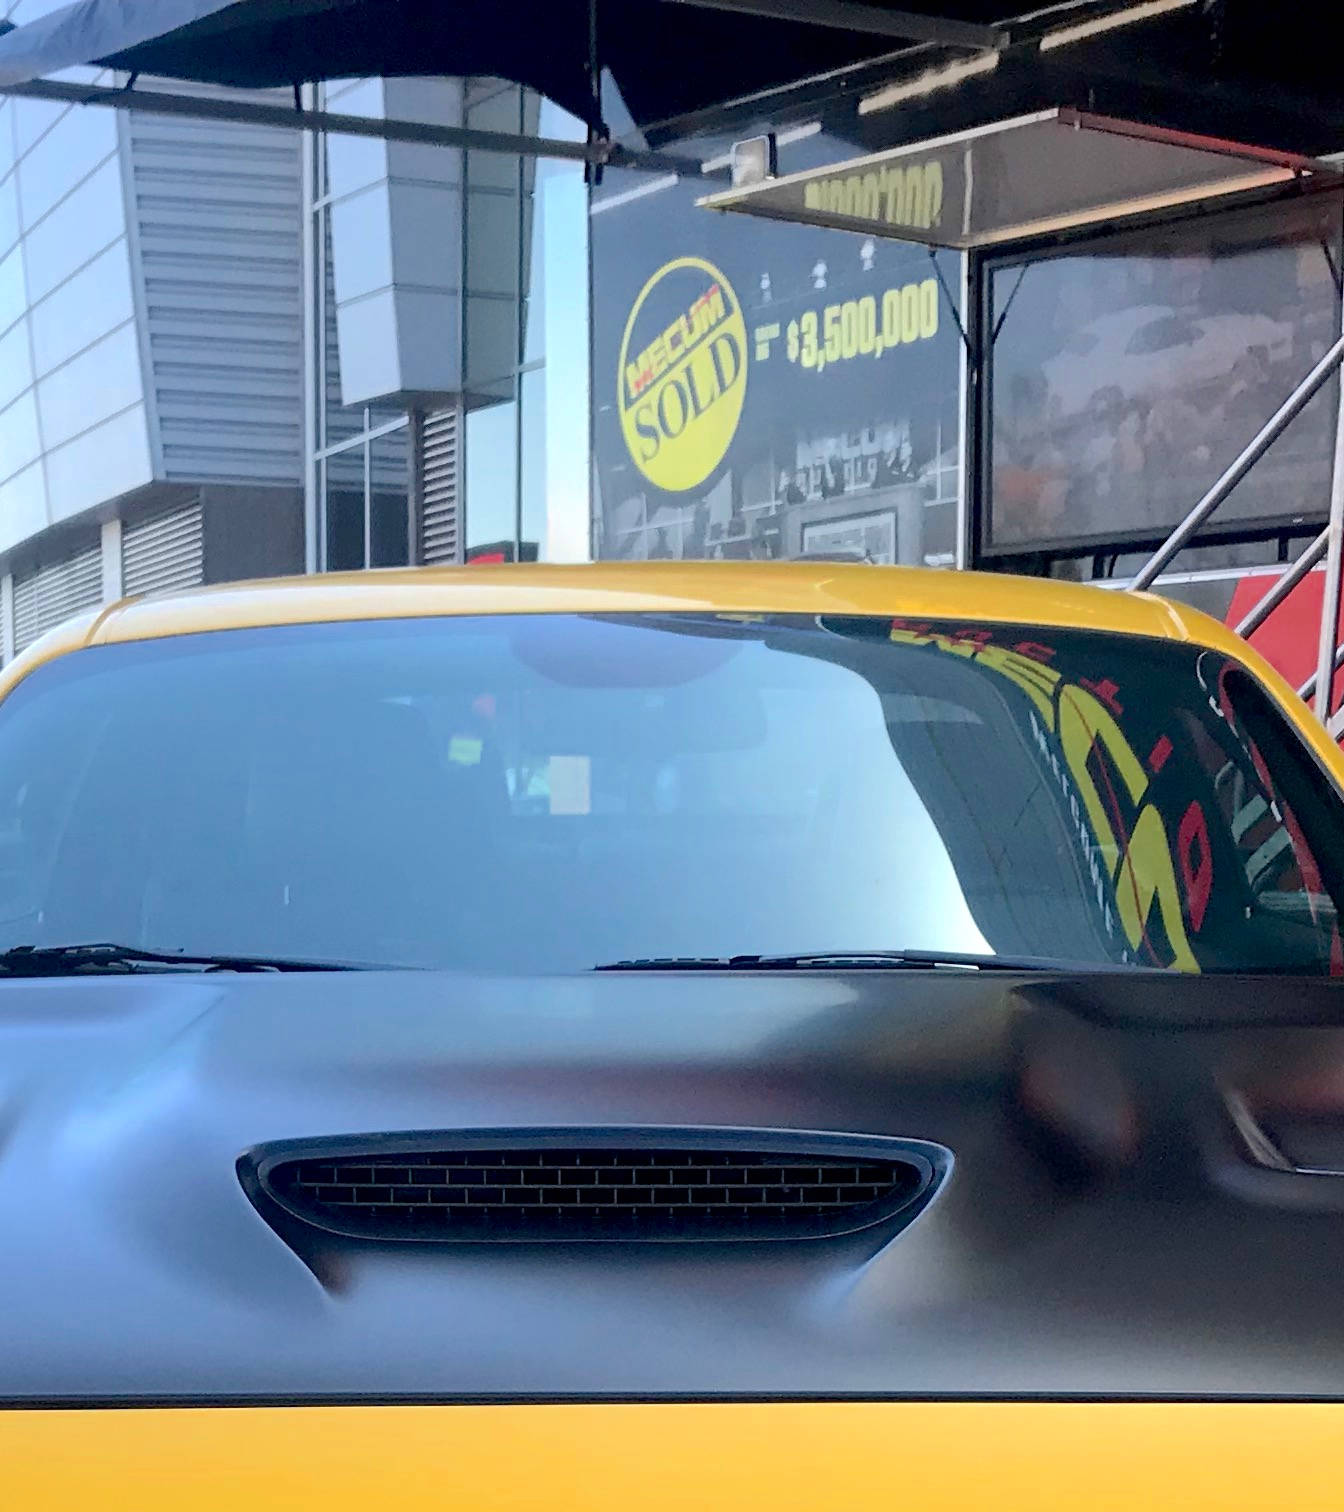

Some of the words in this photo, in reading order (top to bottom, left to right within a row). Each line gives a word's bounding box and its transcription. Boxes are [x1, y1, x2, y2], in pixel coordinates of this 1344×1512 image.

[626, 283, 727, 399] MECUM
[787, 278, 939, 372] $3,500,000
[635, 332, 741, 463] SOLD
